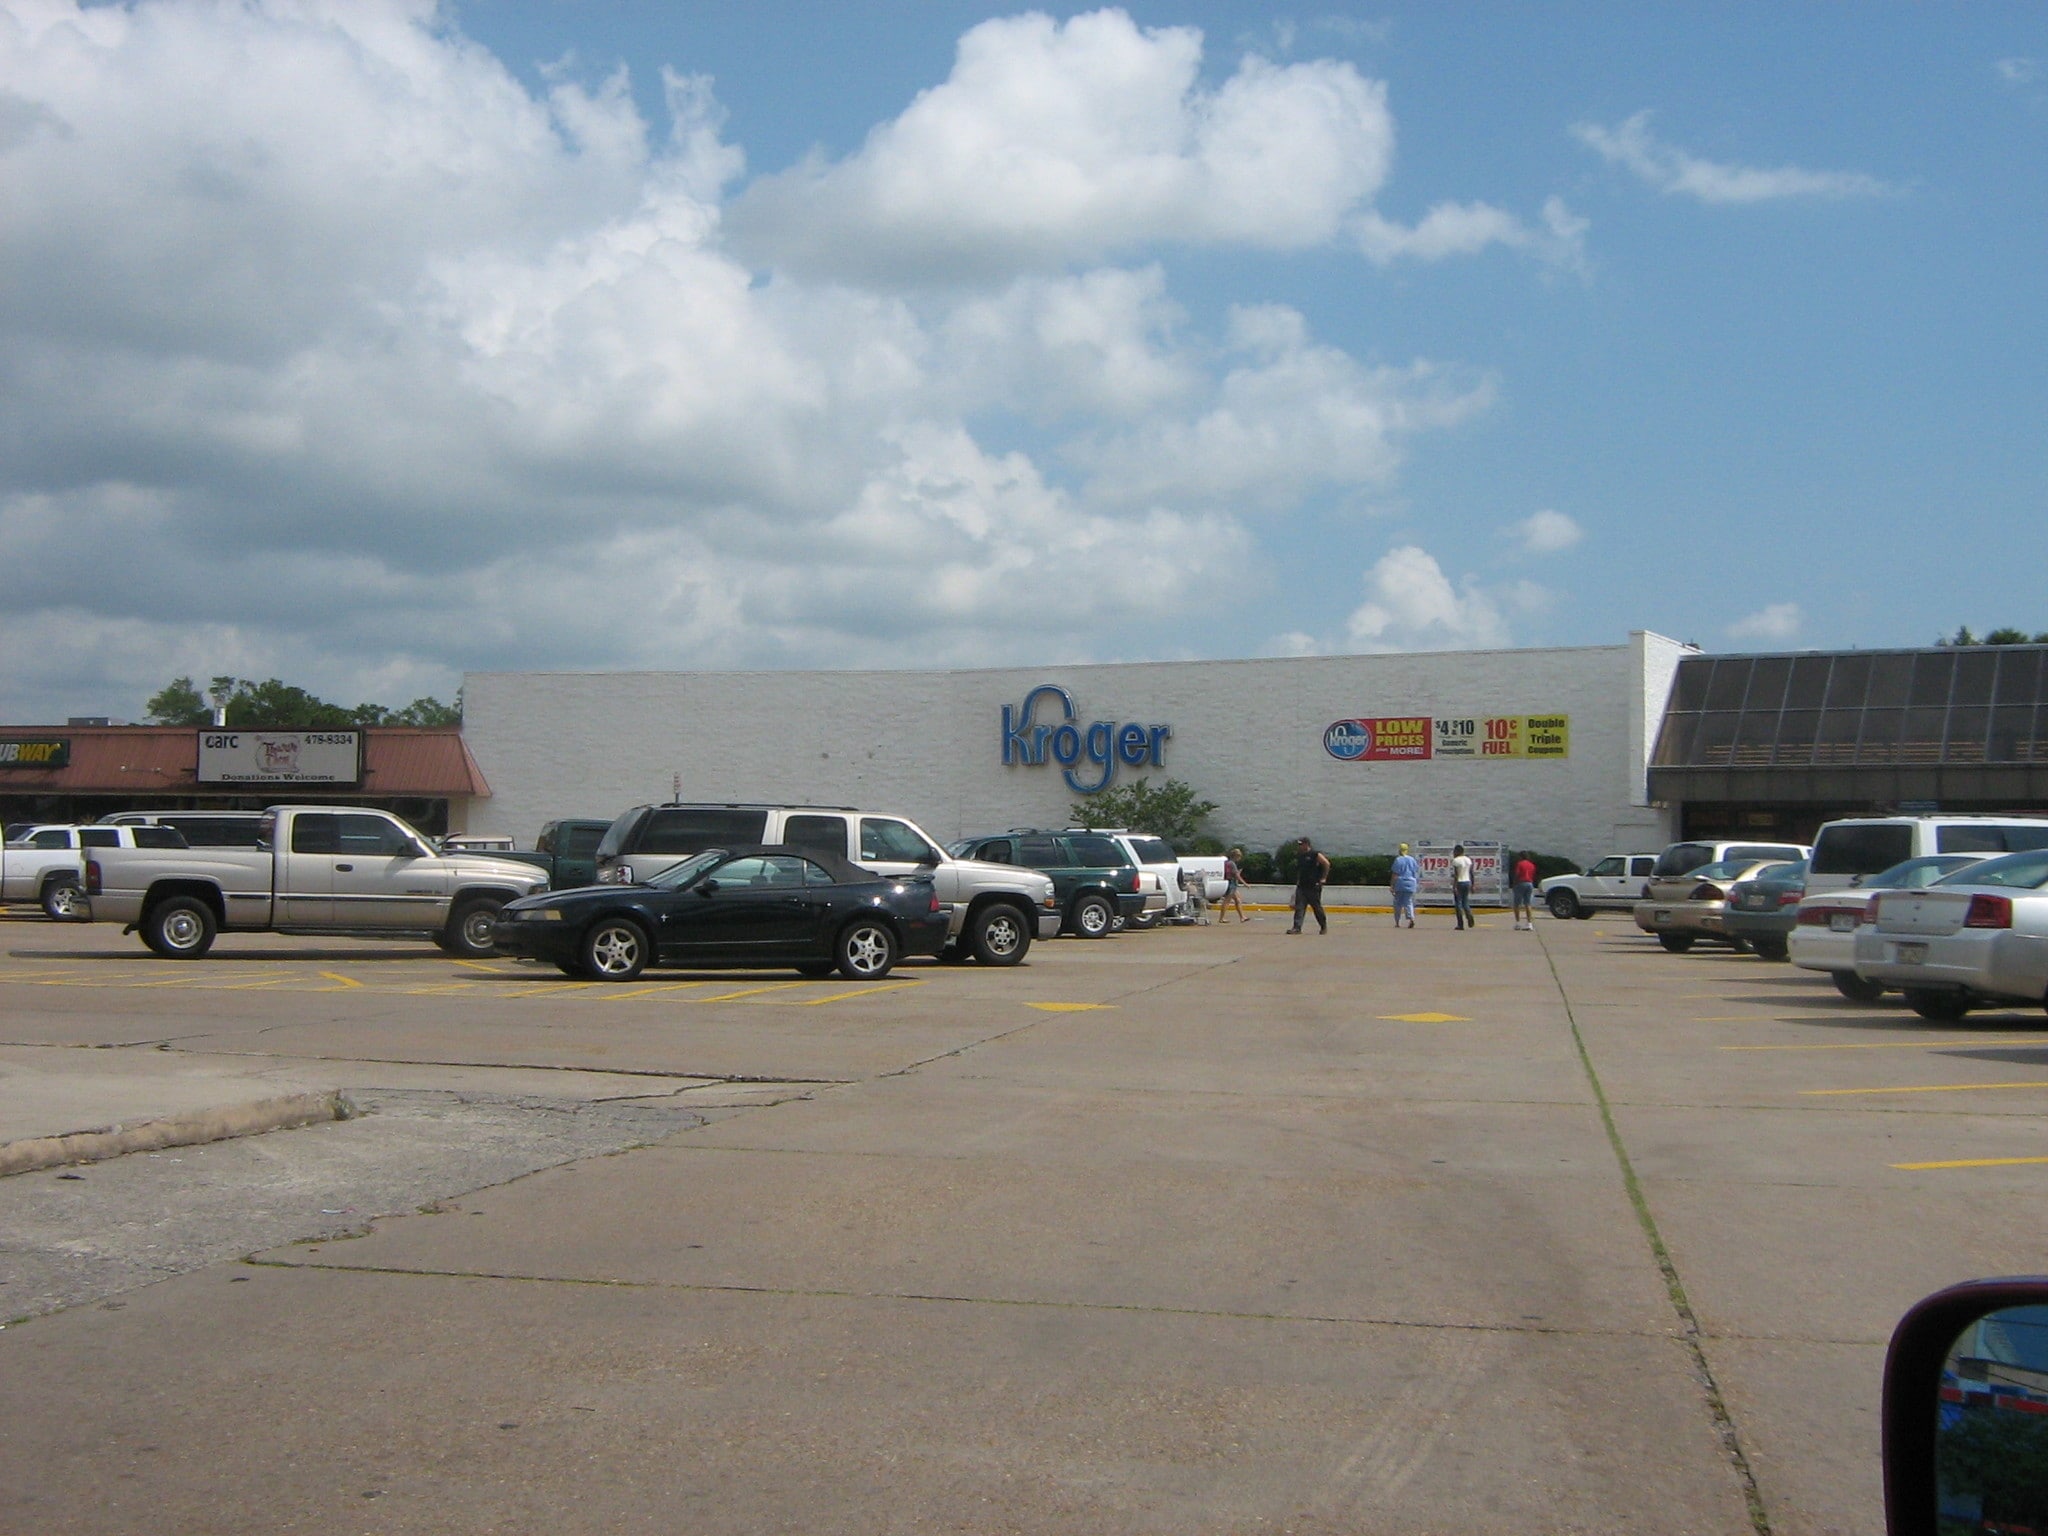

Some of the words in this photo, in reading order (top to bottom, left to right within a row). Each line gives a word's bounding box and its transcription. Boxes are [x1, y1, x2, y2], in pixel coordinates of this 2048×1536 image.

[1375, 720, 1424, 734] LOW
[1528, 718, 1565, 728] Double
[1000, 684, 1172, 794] Kroger
[1329, 725, 1368, 755] Kroger
[1375, 735, 1425, 746] PRICES
[1530, 734, 1562, 744] Triple
[1389, 746, 1424, 755] MORE!
[1482, 741, 1513, 754] FUEL
[1527, 746, 1564, 754] Coupons
